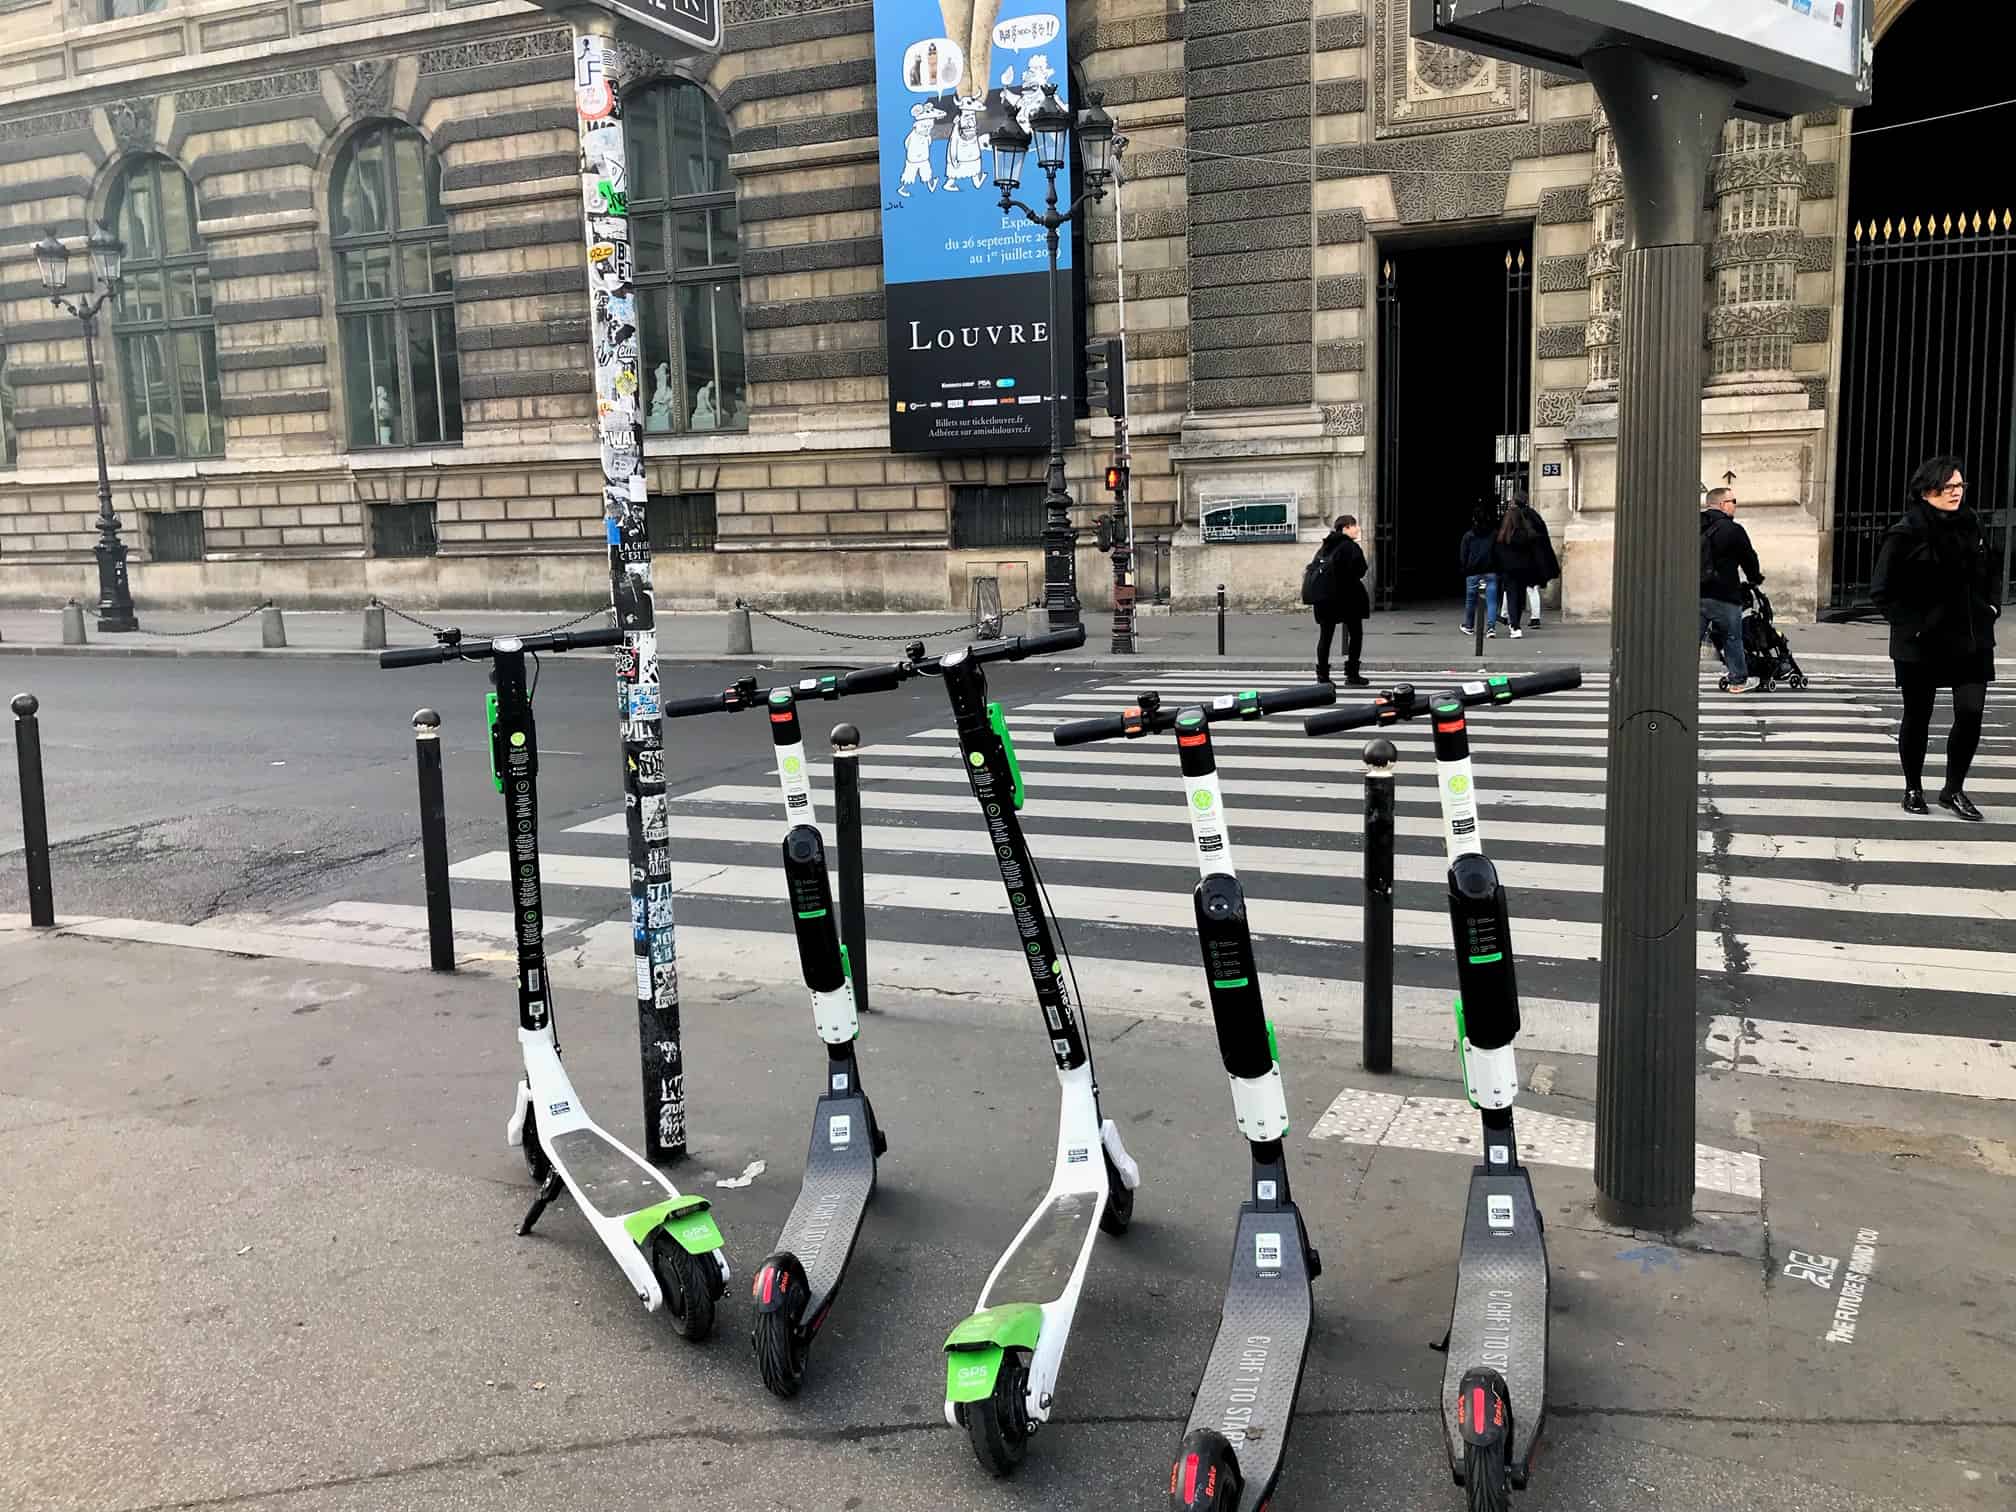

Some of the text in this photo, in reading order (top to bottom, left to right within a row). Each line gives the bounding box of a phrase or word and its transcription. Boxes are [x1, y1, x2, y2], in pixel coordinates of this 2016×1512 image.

[945, 237, 960, 251] du
[962, 237, 975, 249] 26
[977, 232, 1033, 250] septembre
[969, 254, 983, 265] au
[999, 248, 1032, 265] juillet
[909, 320, 1049, 351] LOUVRE
[935, 414, 1025, 428] Billets sur ticketlouvre.fr
[973, 424, 1032, 436] amisdulouvre.fr
[1544, 465, 1559, 475] 93
[1239, 1335, 1272, 1374] €/CHF
[1229, 1386, 1258, 1403] TO
[1205, 1464, 1217, 1497] Brake
